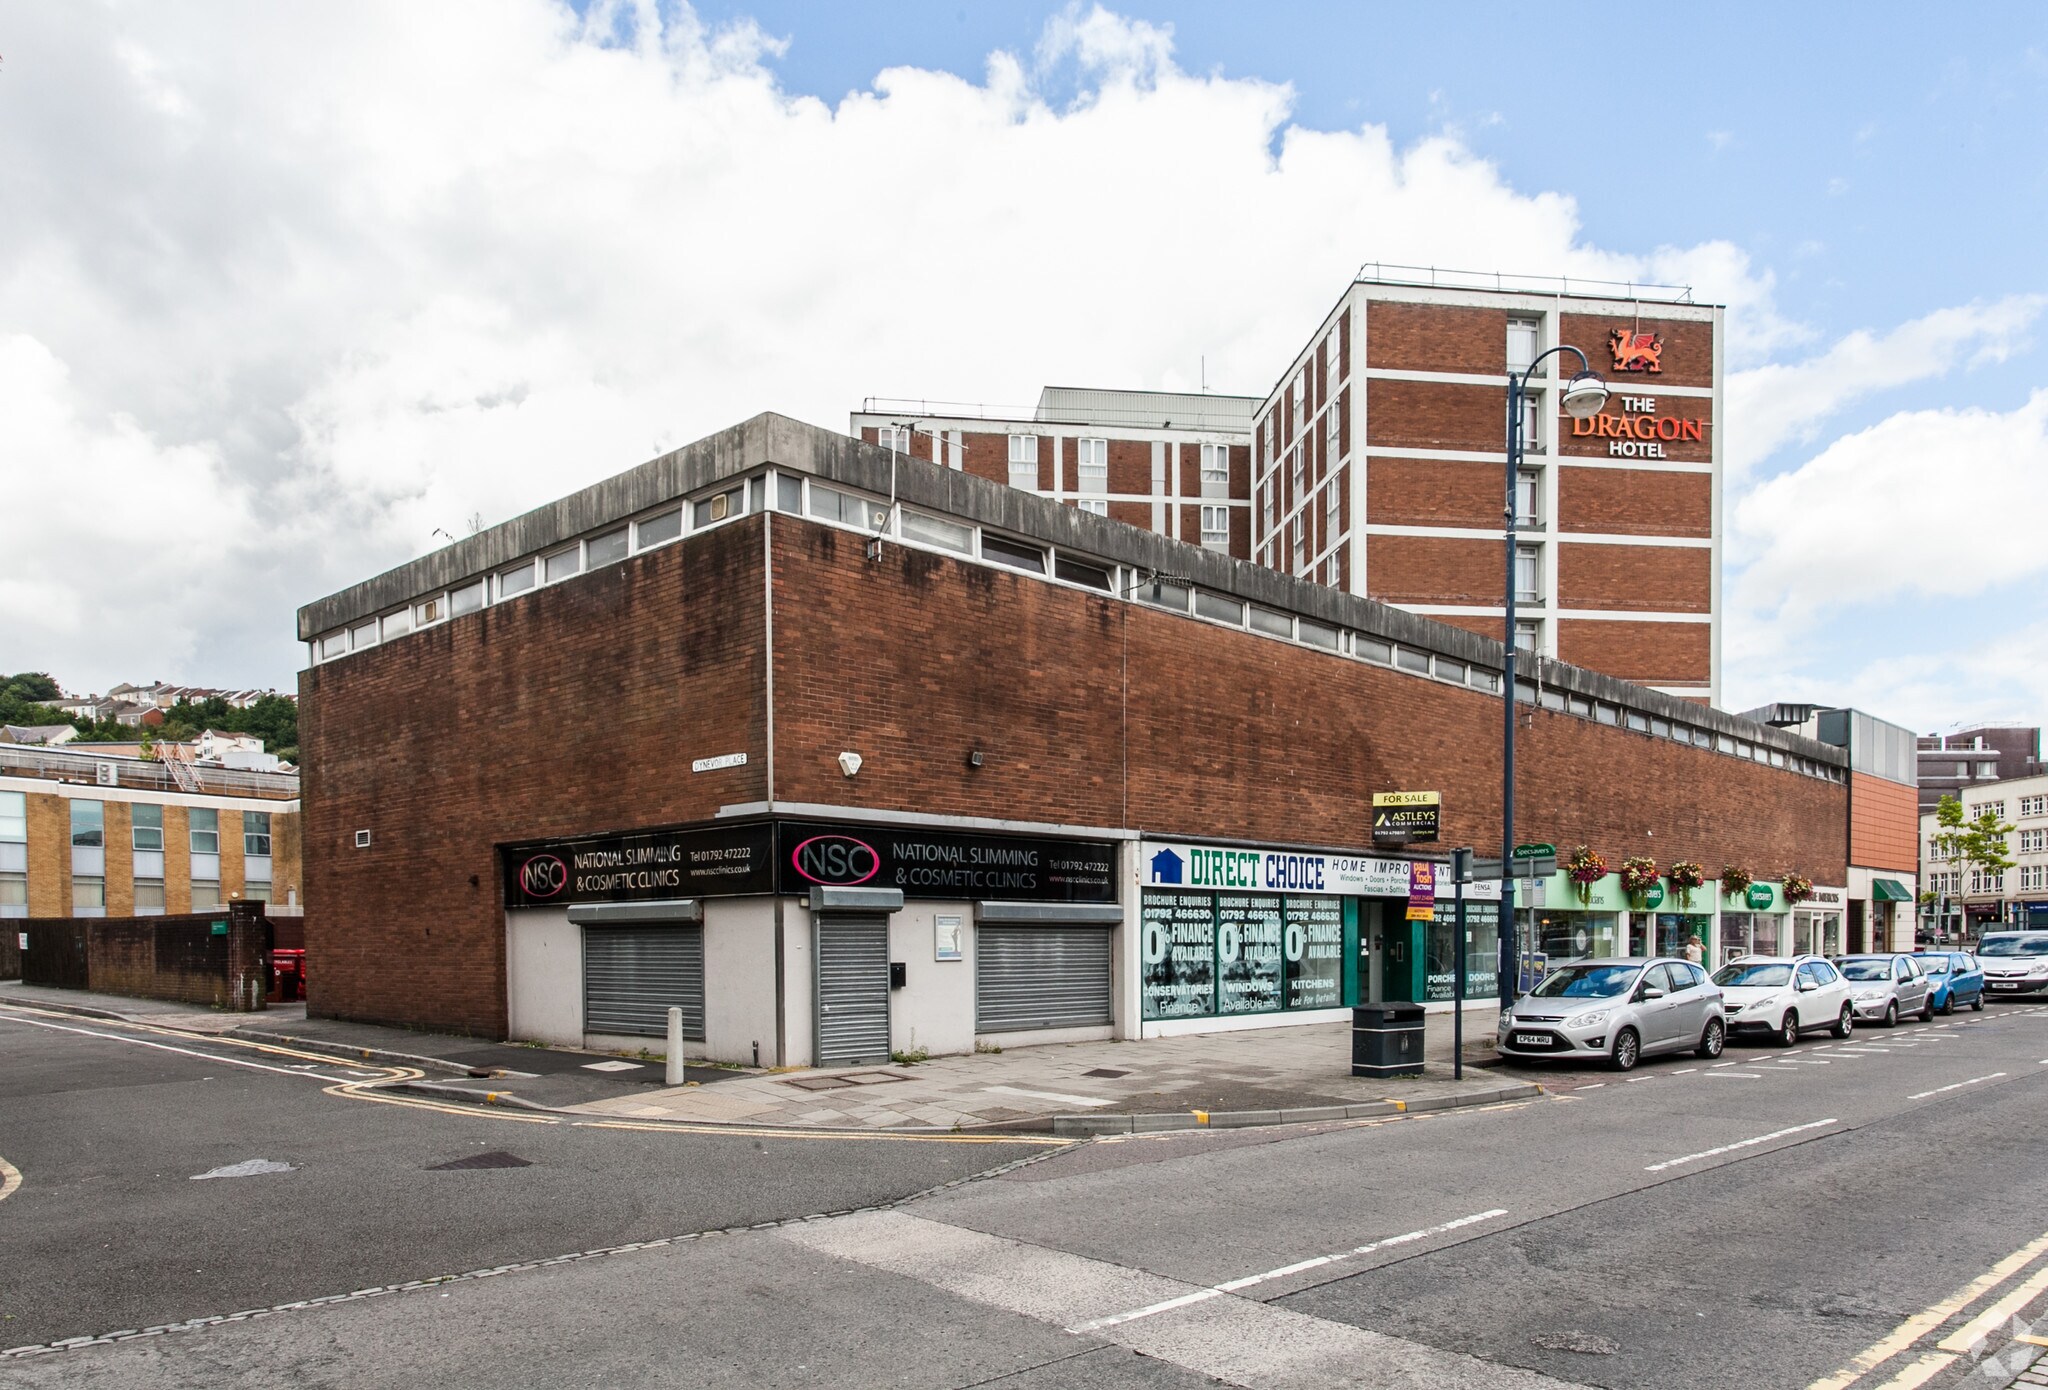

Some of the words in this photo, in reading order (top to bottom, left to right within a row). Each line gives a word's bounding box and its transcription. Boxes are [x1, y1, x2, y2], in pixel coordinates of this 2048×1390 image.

[1621, 396, 1656, 413] THE
[1572, 414, 1703, 442] DRAGON
[1608, 440, 1667, 458] HOTEL
[725, 754, 744, 766] PLACE
[1383, 795, 1402, 803] FOR
[1404, 794, 1428, 802] SALE
[1392, 811, 1436, 821] ASTLEYS
[574, 850, 625, 870] NATIONAL
[625, 844, 681, 865] SLIMMING
[690, 852, 701, 862] Tel
[701, 850, 723, 861] 01792
[724, 847, 751, 859] 472222
[892, 842, 968, 863] NATIONAL
[970, 847, 1039, 867] SLIMMING
[1516, 848, 1550, 856] Specsavers
[802, 843, 871, 878] NSC
[1049, 859, 1060, 869] Tel
[1061, 860, 1083, 871] 01792
[1084, 862, 1109, 872] 472222
[524, 861, 562, 890] NSC
[690, 863, 751, 876] www.nscclinics.co.uk
[1190, 848, 1261, 888] DIRECT
[1265, 854, 1325, 890] CHOICE
[1331, 859, 1367, 873] HOME
[1413, 862, 1429, 876] paul
[576, 876, 585, 892] &
[585, 872, 637, 891] COSMETIC
[637, 869, 680, 888] CLINICS
[895, 867, 907, 885] &
[909, 867, 984, 887] COSMETIC
[985, 871, 1037, 889] CLINICS
[1049, 875, 1109, 885] www.nscclinics.co.uk
[1340, 873, 1363, 883] Windows
[1369, 874, 1386, 884] Doors
[1416, 870, 1433, 884] fosh
[1364, 884, 1384, 893] Fascias
[1389, 886, 1406, 894] Soffits
[1474, 883, 1491, 891] FENSA
[1143, 895, 1177, 906] BROCHURE
[1179, 895, 1212, 907] ENQUIRIES
[1751, 891, 1772, 901] Specsavers
[1219, 897, 1249, 908] BROCHURE
[1250, 898, 1280, 909] ENQUIRIES
[1144, 908, 1173, 919] 01792
[1175, 908, 1212, 919] 466630
[1220, 909, 1245, 920] 01792
[1247, 910, 1279, 920] 466630
[1286, 911, 1309, 921] 01792
[1311, 911, 1340, 921] 466630
[1244, 923, 1281, 943] FINANCE
[1308, 924, 1341, 943] FINANCE
[1142, 922, 1171, 965] 0%
[1172, 923, 1214, 943] FINANCE
[1172, 946, 1214, 962] AVAILABLE
[1244, 945, 1281, 961] AVAILABLE
[1308, 944, 1341, 959] AVAILABLE
[1427, 974, 1456, 984] PORCHE
[1468, 972, 1496, 982] DOORS
[1143, 984, 1214, 997] CONSERVATORIES
[1226, 981, 1274, 993] WINDOWS
[1291, 978, 1335, 990] KITCHENS
[1427, 984, 1452, 993] Finance
[1223, 997, 1263, 1012] Available
[1290, 996, 1302, 1007] Ask
[1303, 995, 1314, 1005] For
[1160, 1001, 1198, 1015] Finance
